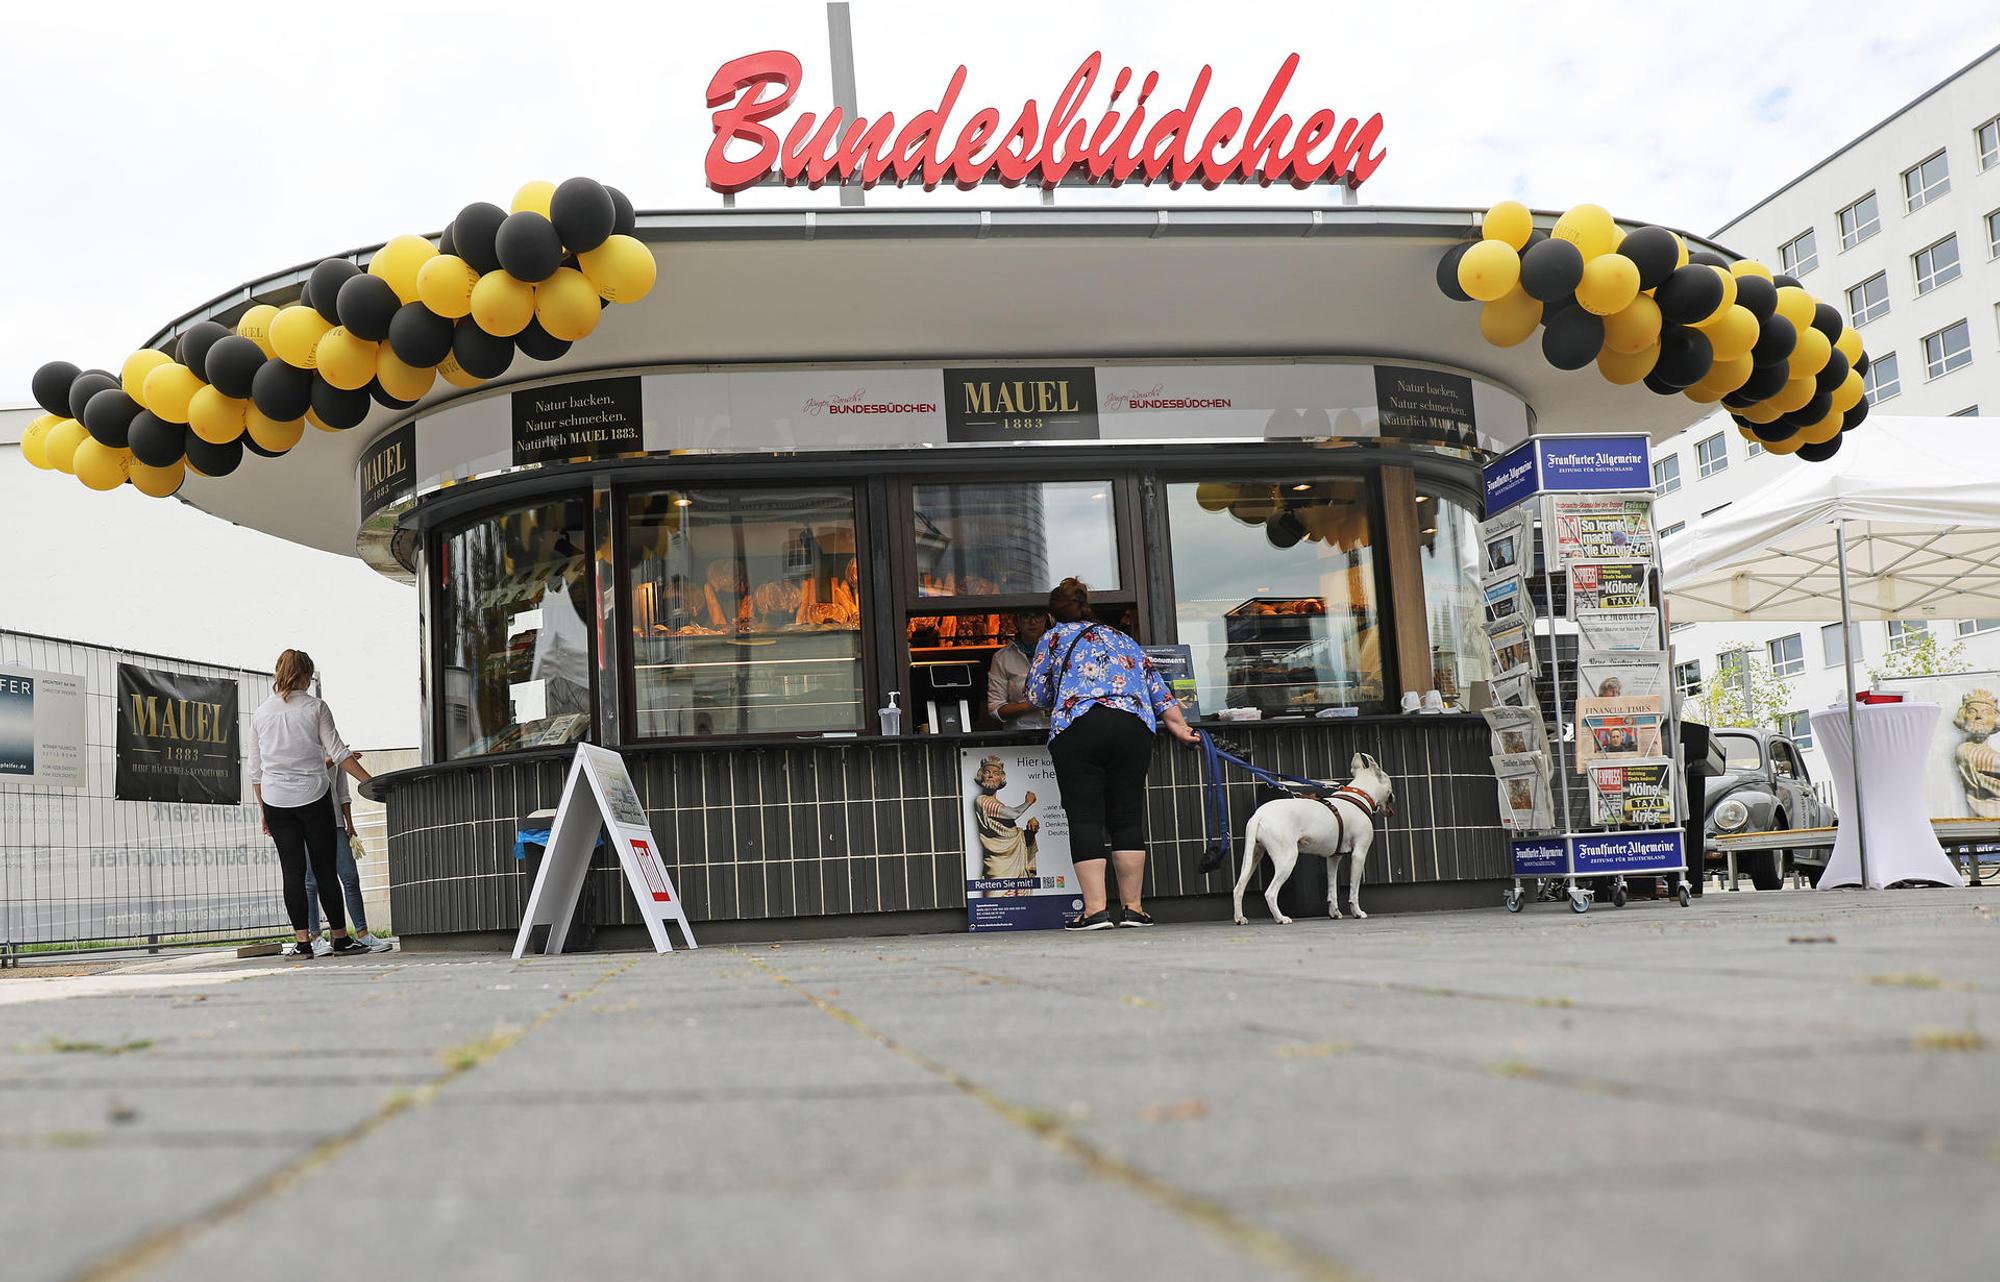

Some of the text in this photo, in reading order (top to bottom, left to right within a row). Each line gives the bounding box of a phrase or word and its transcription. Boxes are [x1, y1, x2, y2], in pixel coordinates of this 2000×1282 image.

[705, 50, 1387, 193] Bundesbüdchen
[1398, 380, 1424, 393] Natur
[963, 381, 1079, 414] MAUEL
[1129, 396, 1232, 410] BUNDESBÜDCHEN
[1390, 396, 1418, 409] Natur
[535, 400, 569, 413] Natur
[829, 402, 936, 415] BUNDESBÜDCHEN
[525, 419, 557, 433] Natur
[1003, 417, 1044, 430] 1883
[516, 434, 567, 453] Natürlich
[569, 431, 609, 444] MAUEL
[1547, 452, 1642, 468] Frankfurter Allgemeine
[362, 442, 407, 496] MAUEL
[1581, 519, 1625, 531] So krank
[1583, 533, 1612, 544] macht
[1605, 580, 1638, 594] Kölner
[1625, 705, 1652, 713] TIMES
[131, 693, 228, 744] MAUEL
[167, 747, 199, 761] 1883
[1017, 757, 1039, 768] Hier
[1598, 769, 1622, 785] EXPRESS
[1630, 782, 1663, 796] Kölner
[1635, 799, 1661, 807] TAXI
[1632, 810, 1661, 825] Krieg
[1516, 846, 1564, 861] Frankfurter Allgemeine
[1579, 840, 1674, 858] Frankfurter Allgemeine
[1627, 854, 1666, 862] DEUTSCHLAND
[975, 879, 1034, 889] Retten Sie mit!
